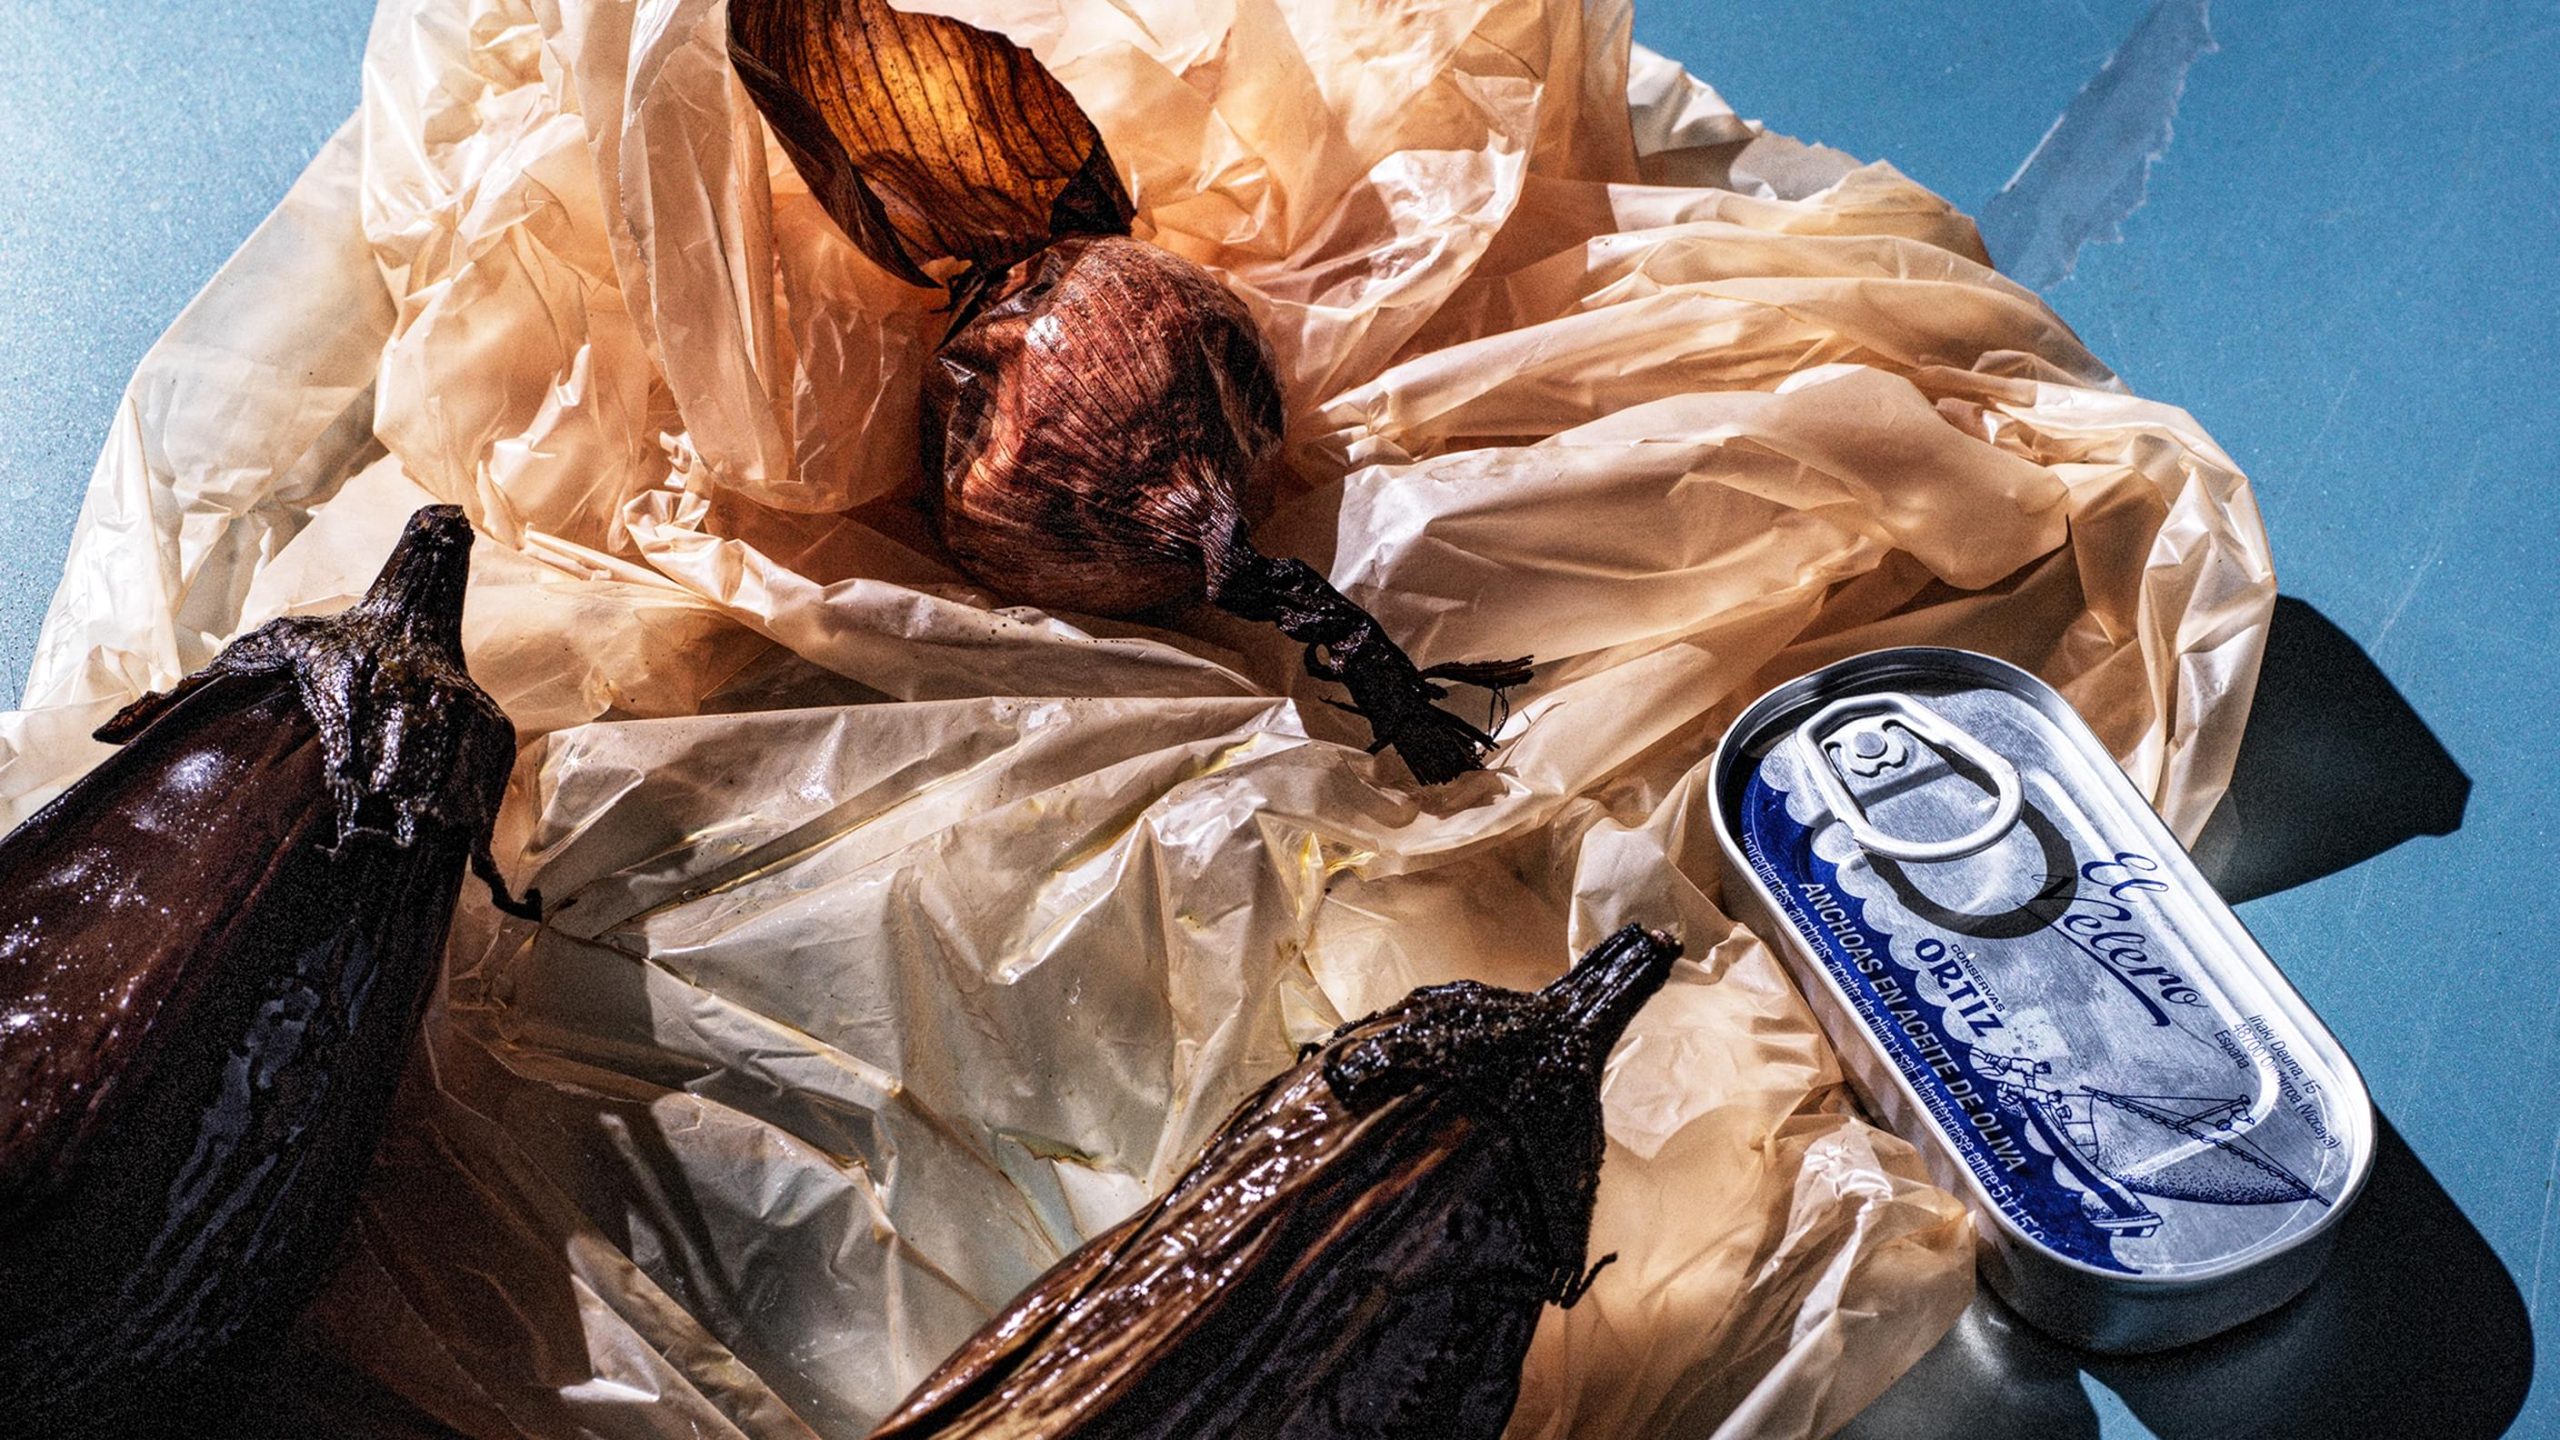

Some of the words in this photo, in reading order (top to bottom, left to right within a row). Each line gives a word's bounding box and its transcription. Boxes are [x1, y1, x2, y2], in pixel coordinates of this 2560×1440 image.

[2081, 852, 2169, 902] El
[2031, 873, 2208, 1008] Velero
[1915, 938, 2004, 1037] ORTIZ
[1951, 943, 2005, 1012] CONSERVAS
[1798, 883, 1883, 974] ANCHOAS
[1869, 976, 1908, 1006] EN
[1890, 1009, 1960, 1078] ACEITE
[1945, 1078, 1984, 1110] DE
[1970, 1112, 2027, 1172] OLIVA
[2214, 1029, 2250, 1070] España
[2232, 1023, 2267, 1058] 48700
[2249, 1014, 2276, 1041] Iñaki
[2271, 1041, 2304, 1080] Deuna,
[1827, 961, 1861, 999] aceite
[1854, 998, 1874, 1015] de
[1867, 1016, 1896, 1044] oliva
[1966, 1152, 1999, 1186] entre
[1991, 1184, 2012, 1198] 5
